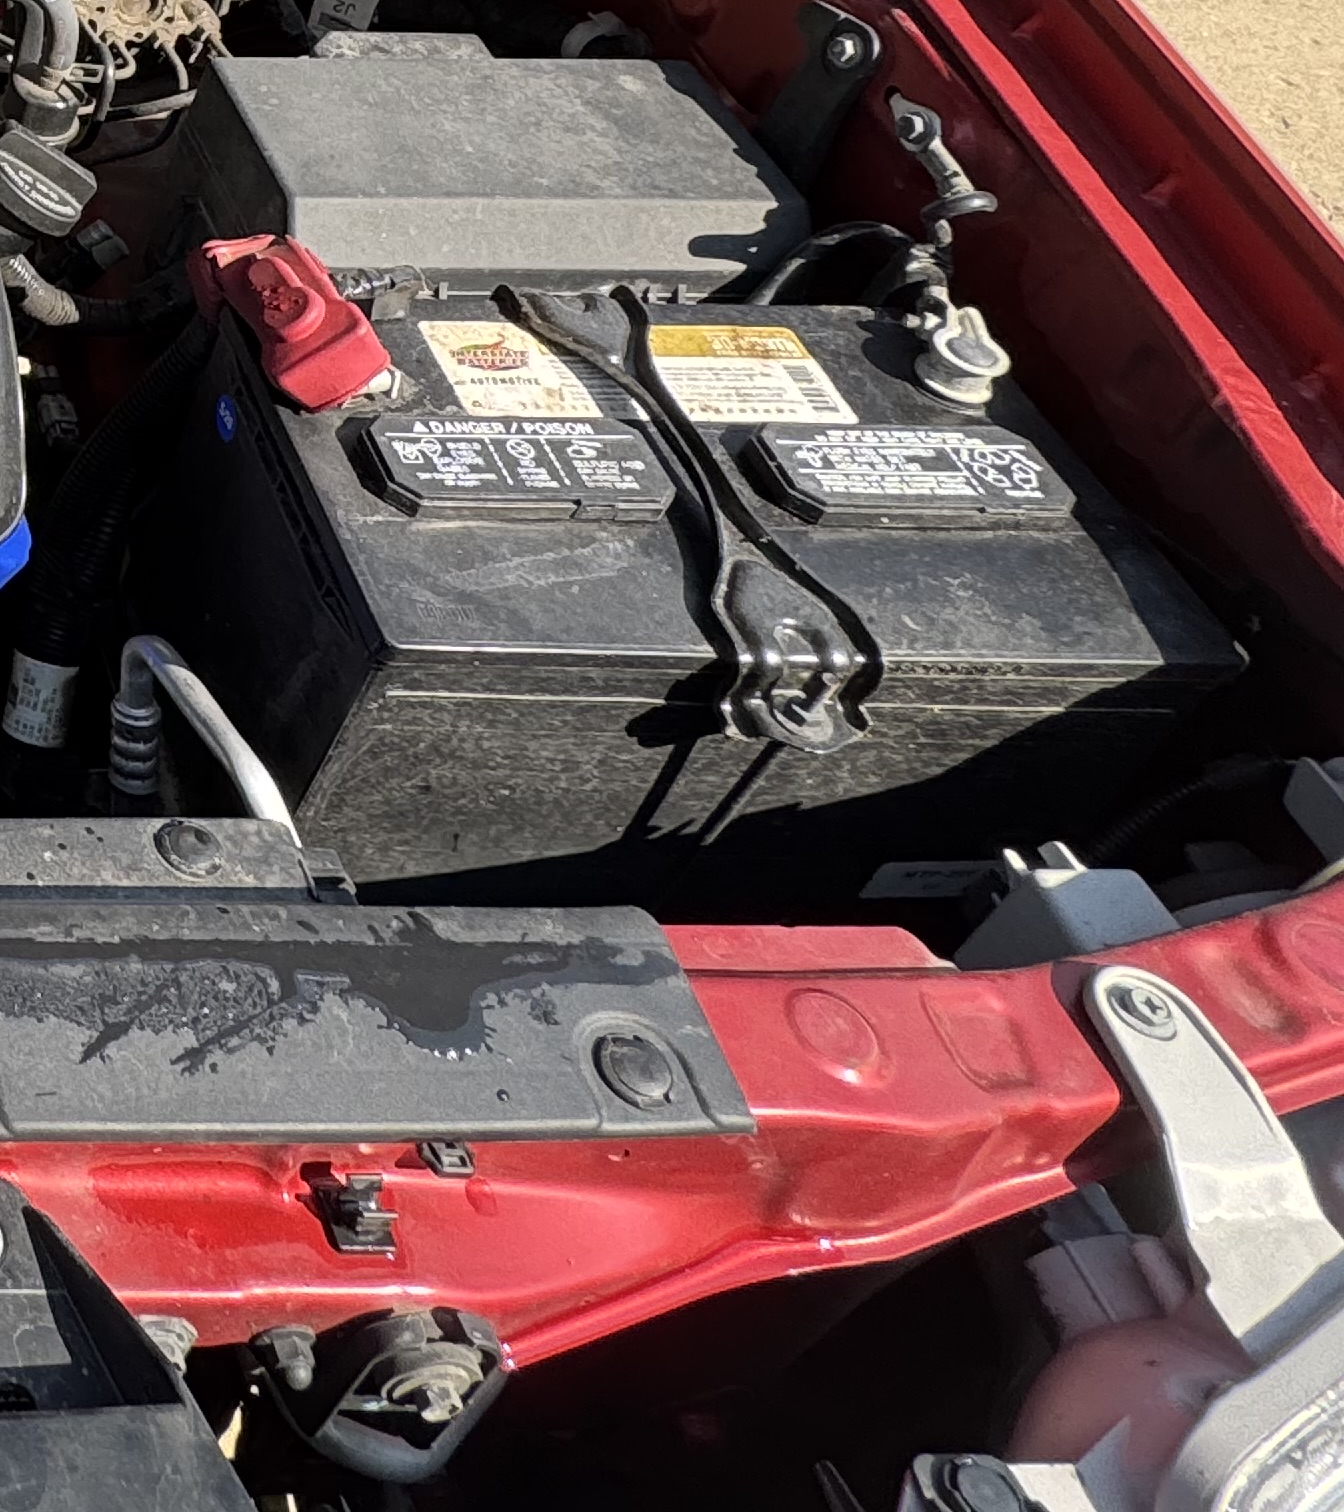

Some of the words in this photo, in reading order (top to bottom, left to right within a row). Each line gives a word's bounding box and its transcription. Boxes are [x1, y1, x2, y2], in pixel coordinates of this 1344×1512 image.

[448, 348, 530, 358] INTERSTATE
[456, 357, 530, 367] BATTERIES
[469, 375, 542, 386] AUTOMOTIVE
[428, 420, 507, 434] DANGER
[521, 421, 595, 435] POISON
